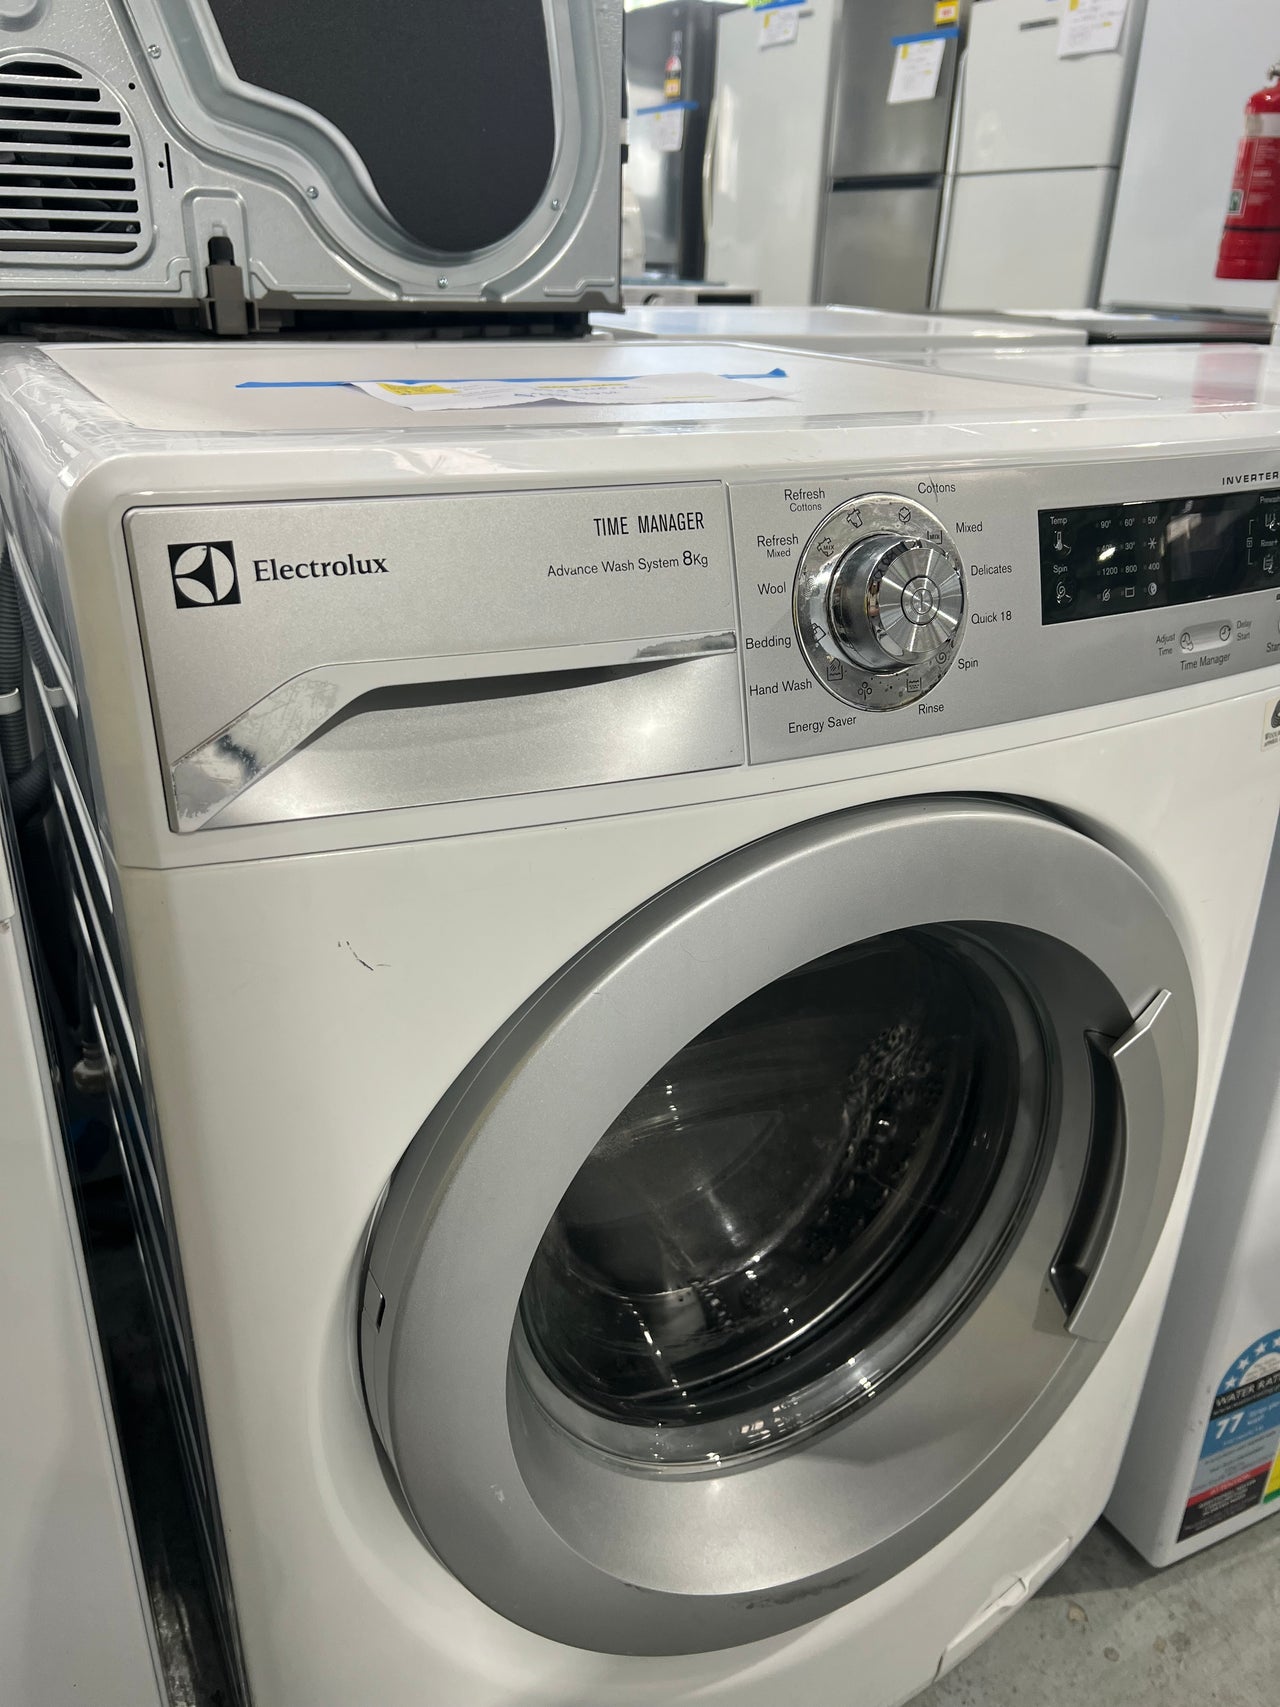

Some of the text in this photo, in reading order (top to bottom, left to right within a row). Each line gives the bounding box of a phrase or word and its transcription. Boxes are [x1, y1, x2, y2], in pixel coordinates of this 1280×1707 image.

[1222, 471, 1279, 485] INVERTER
[917, 482, 956, 494] Cottons
[784, 489, 825, 501] Refresh
[789, 502, 822, 512] Cottons
[593, 511, 705, 537] TIME MANAGER
[1049, 516, 1068, 525] Temp
[956, 521, 983, 533] Mixed
[757, 534, 799, 547] Refresh
[766, 548, 791, 558] Mixed
[254, 554, 389, 583] Electrolux
[547, 549, 709, 577] Advance Wash System 8Kg
[1052, 564, 1068, 574] Spin
[1125, 564, 1138, 573] 800
[1148, 562, 1160, 571] 400
[970, 564, 1013, 576] Delicates
[1102, 566, 1118, 575] 1200
[757, 582, 787, 595] Wool
[971, 611, 1013, 626] Quick 18
[1156, 633, 1176, 645] Adjust
[1237, 631, 1251, 641] Start
[746, 636, 792, 650] Bedding
[1158, 646, 1173, 656] Time
[957, 657, 979, 671] Spin
[1180, 652, 1231, 671] Time Manager
[749, 679, 813, 696] Hand Wash
[918, 703, 945, 715] Rinse
[788, 716, 857, 734] Energy Saver
[1215, 1384, 1255, 1407] WATER
[1258, 1375, 1280, 1389] RAT
[1216, 1411, 1245, 1440] 77
